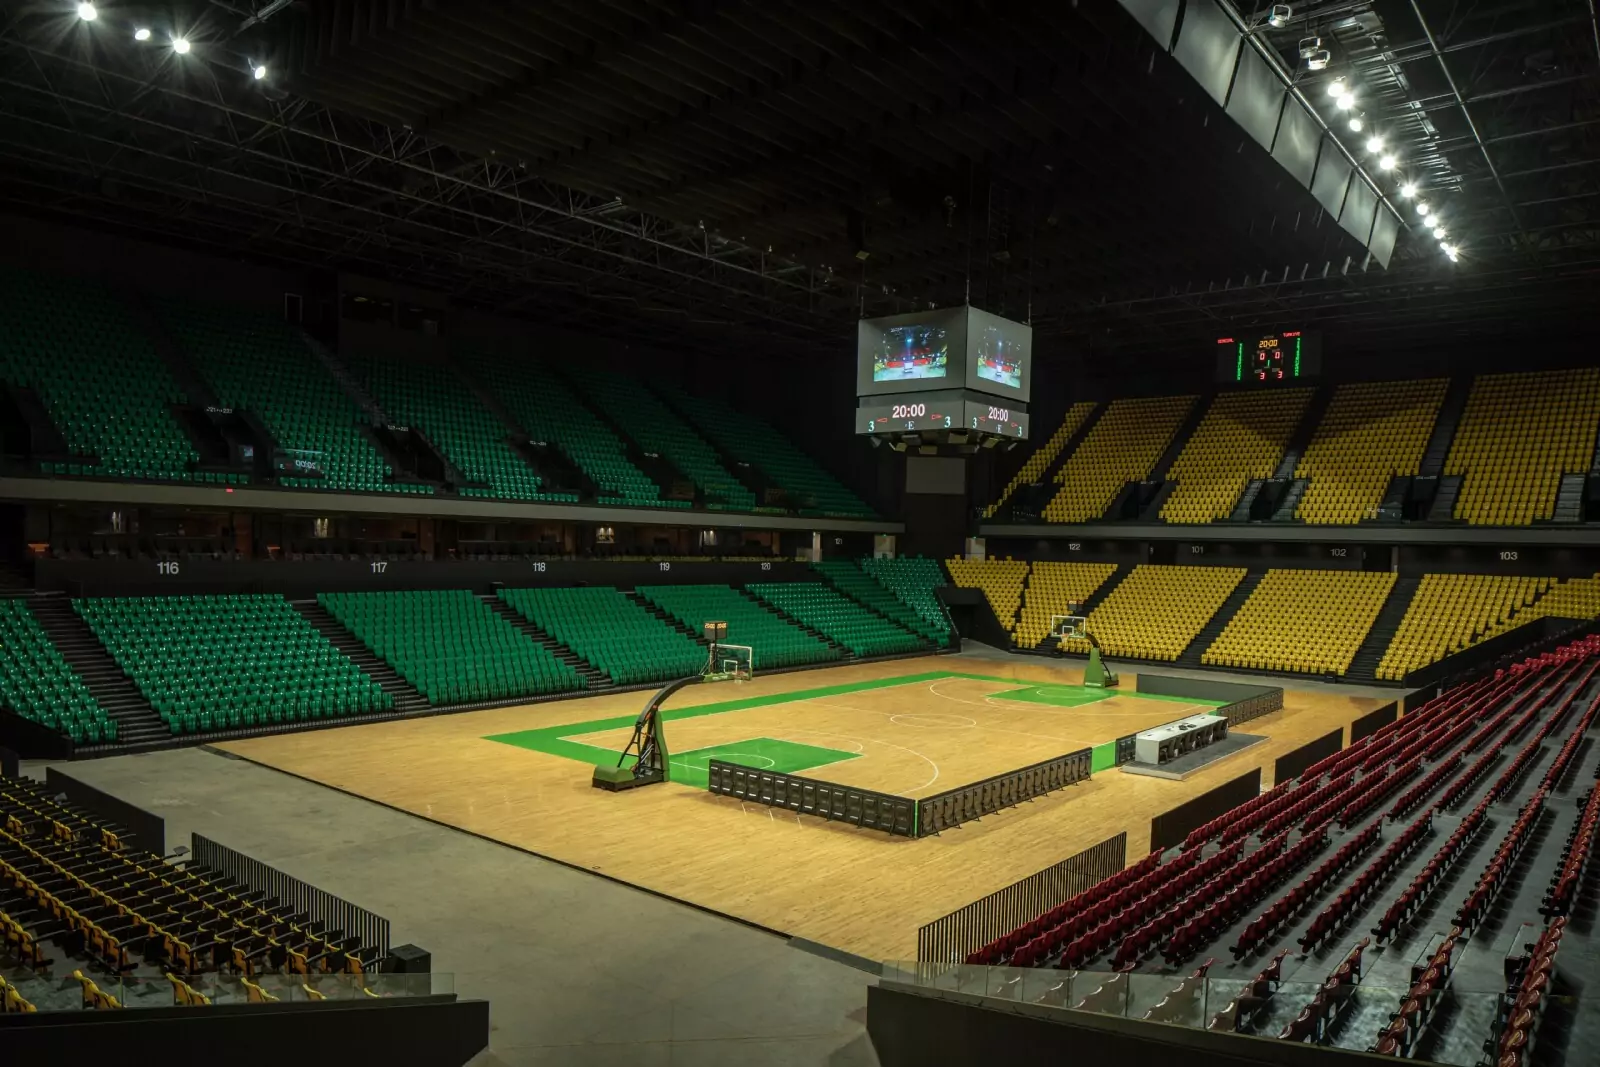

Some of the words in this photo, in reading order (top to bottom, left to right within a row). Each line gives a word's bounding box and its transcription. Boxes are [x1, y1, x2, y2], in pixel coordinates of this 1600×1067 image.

[1259, 339, 1278, 348] 20:00
[892, 403, 926, 419] 20:00
[988, 406, 1009, 422] 20:00
[868, 420, 875, 432] 3
[944, 416, 951, 428] 3
[972, 417, 978, 428] 3
[1017, 426, 1023, 437] 3
[1068, 543, 1081, 551] 122
[1191, 545, 1204, 554] 101
[1329, 548, 1347, 557] 102
[1499, 551, 1518, 561] 103
[157, 562, 179, 574] 116
[371, 562, 388, 573] 117
[532, 562, 546, 572] 118
[659, 561, 671, 572] 119
[760, 562, 771, 571] 120
